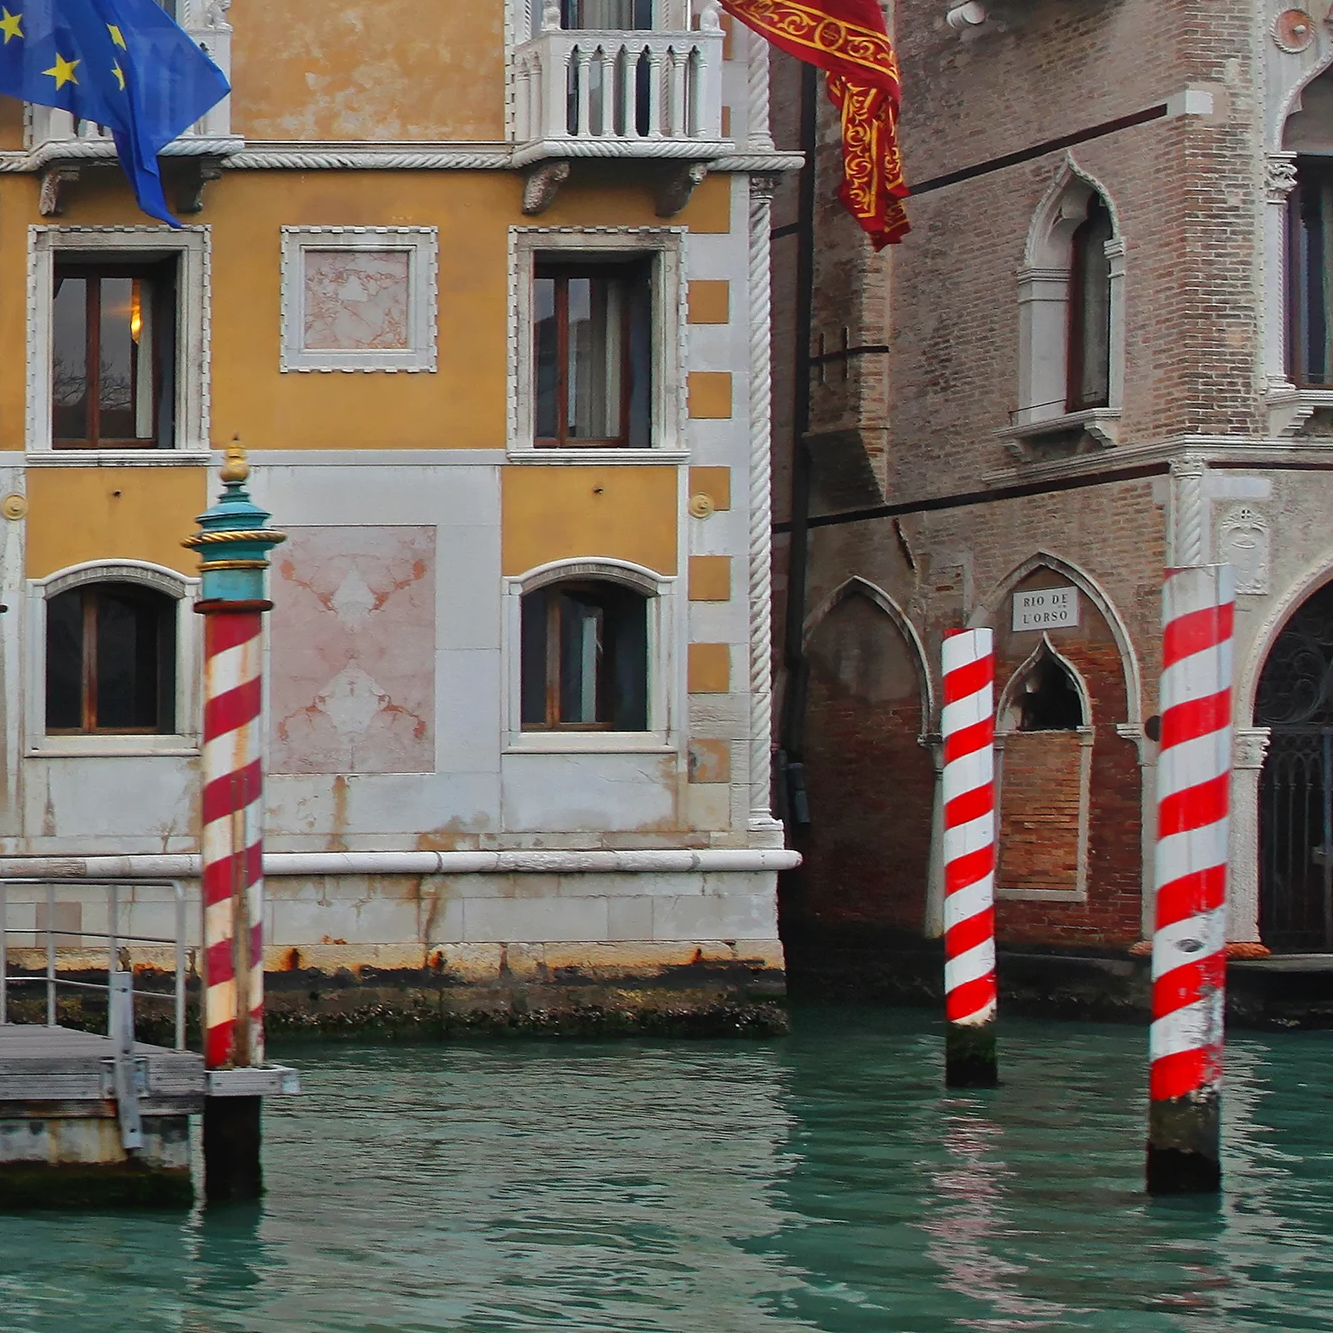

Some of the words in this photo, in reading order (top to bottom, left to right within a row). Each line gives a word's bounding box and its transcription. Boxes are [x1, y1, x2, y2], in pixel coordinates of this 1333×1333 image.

[1023, 596, 1045, 607] RIO
[1052, 594, 1069, 605] DE
[1023, 610, 1068, 624] L'ORSO
